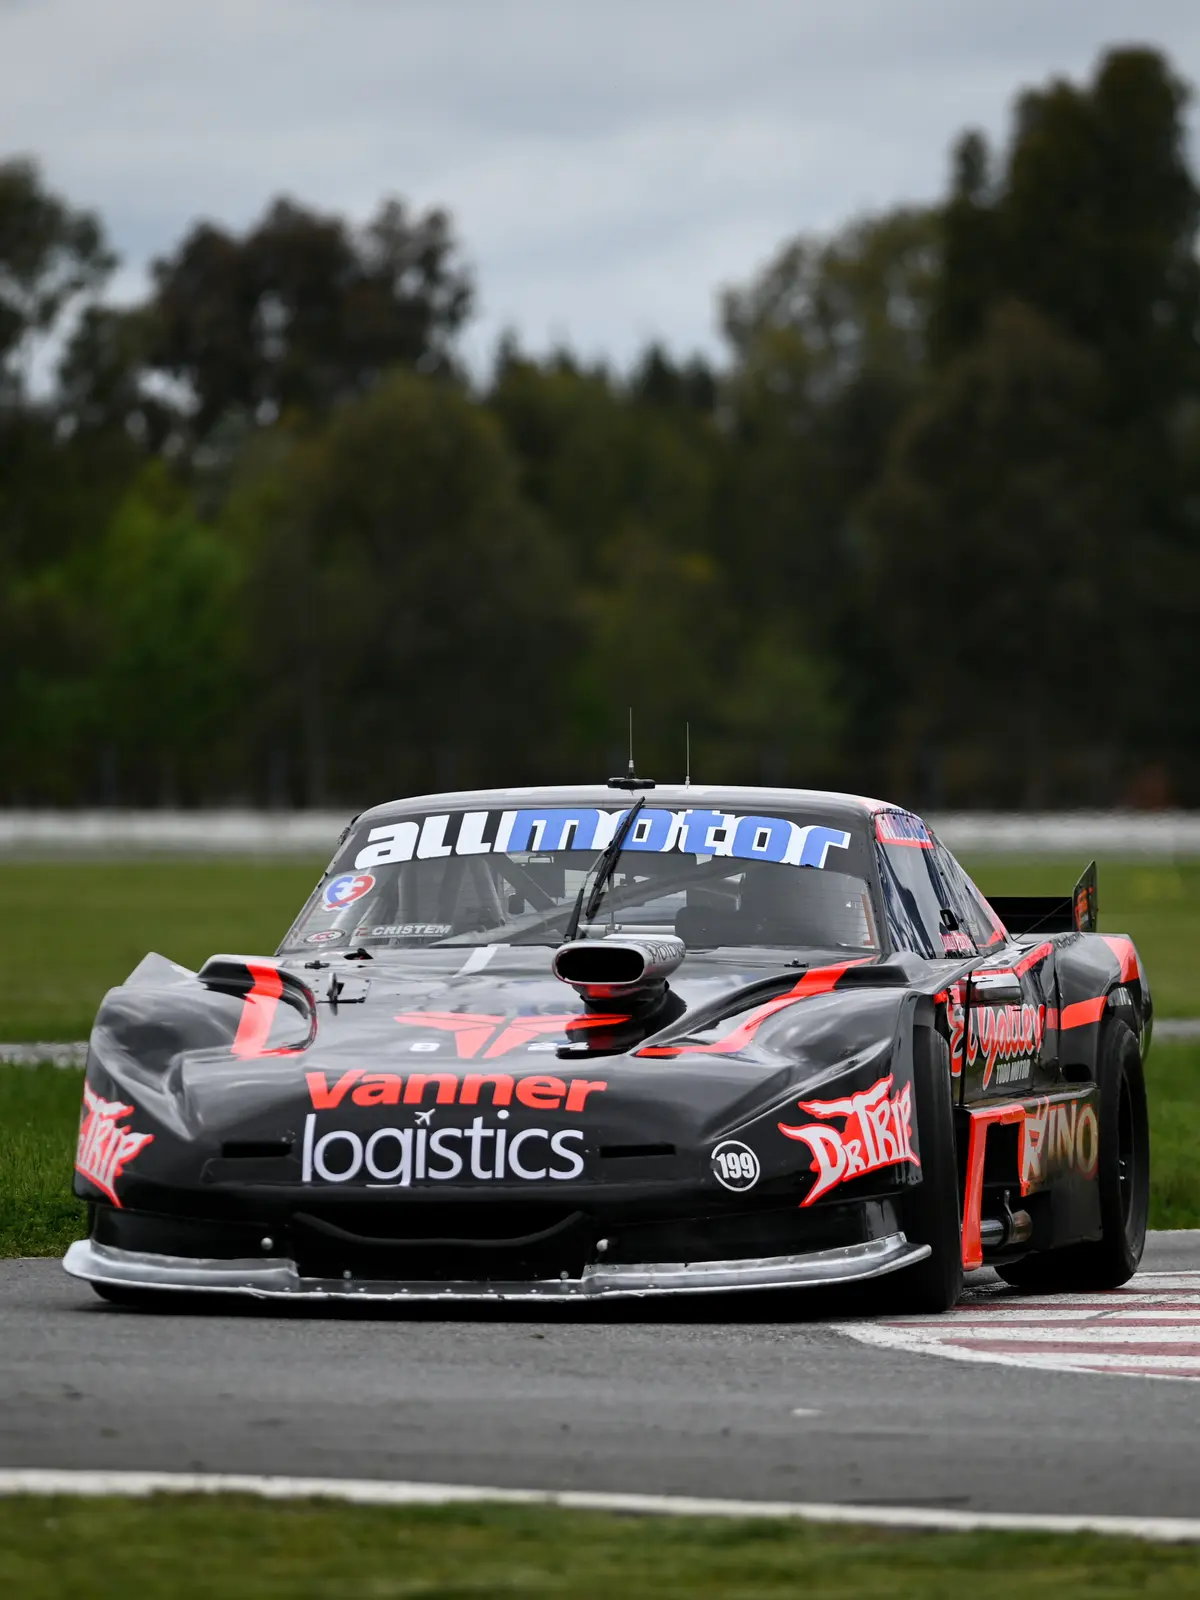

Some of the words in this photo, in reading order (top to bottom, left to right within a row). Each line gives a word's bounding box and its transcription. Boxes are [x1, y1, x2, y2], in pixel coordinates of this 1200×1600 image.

[372, 924, 451, 936] CRISTEM
[305, 1068, 607, 1112] Vanner
[301, 1109, 584, 1188] logistics
[716, 1151, 756, 1179] 199
